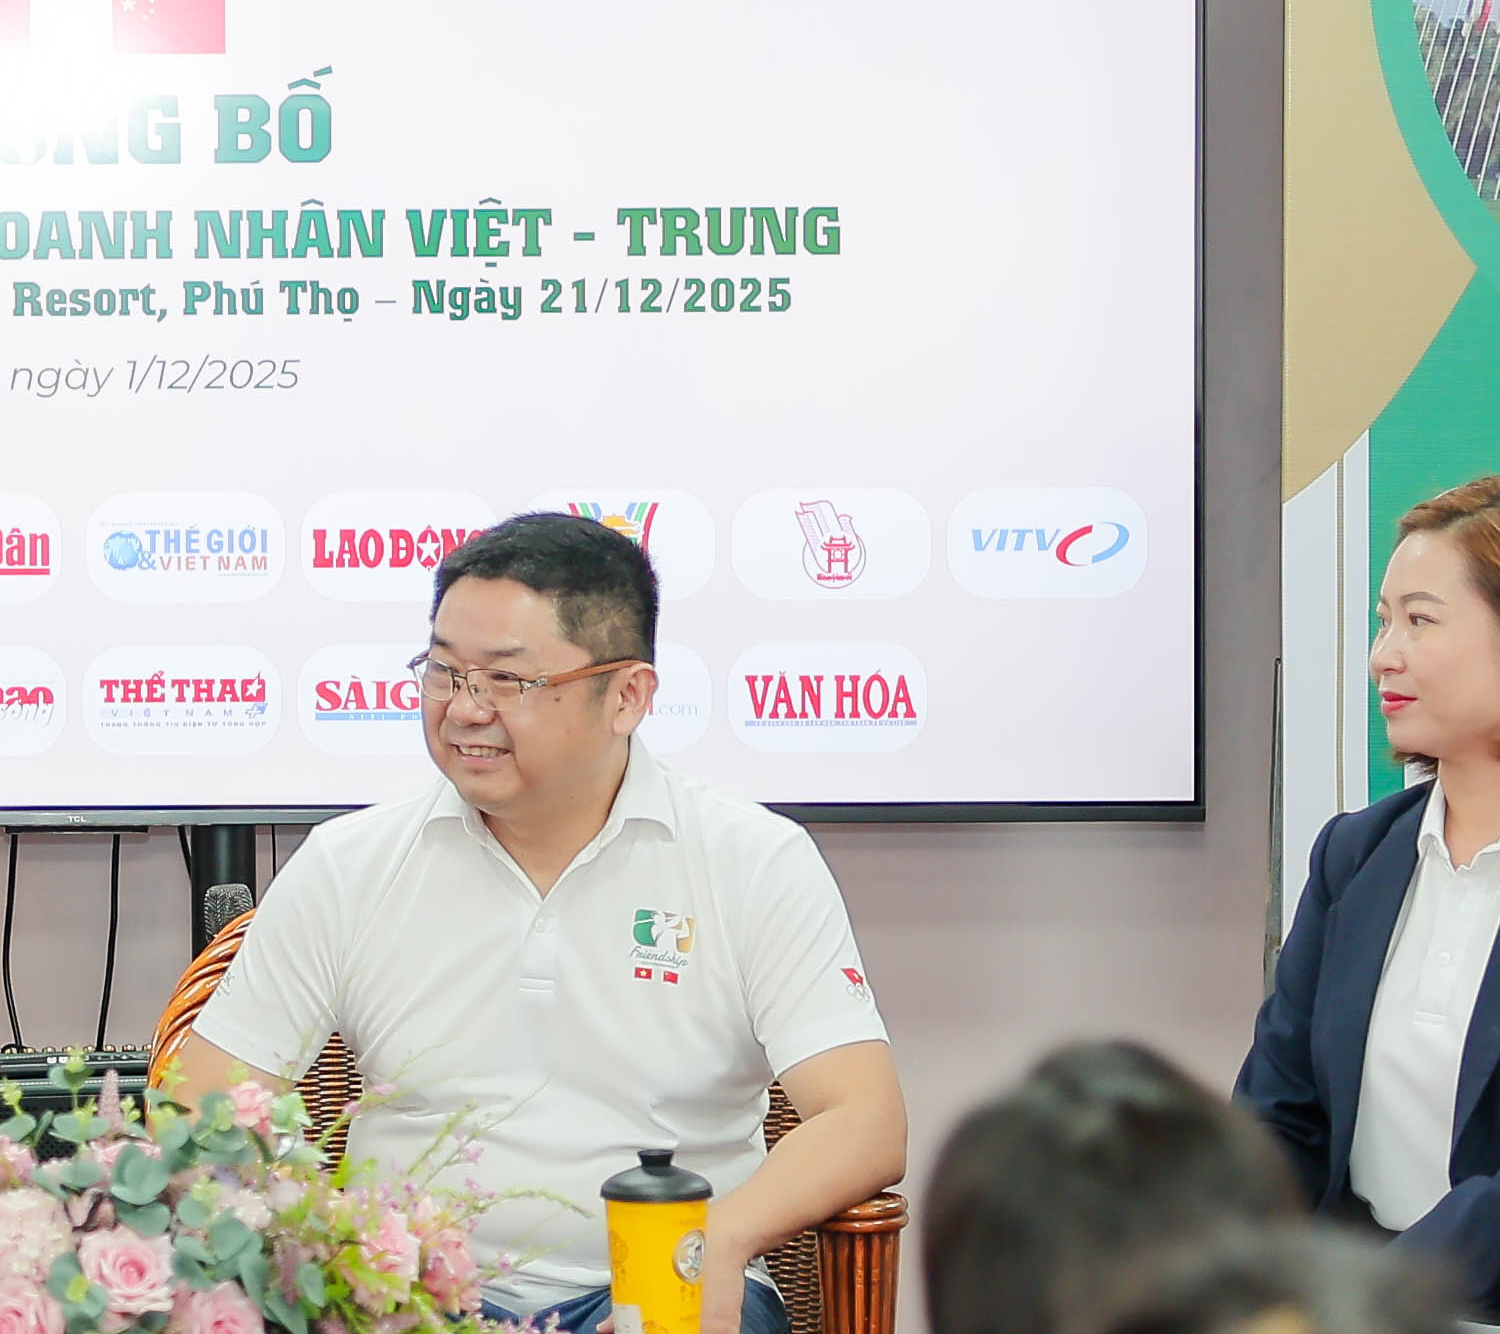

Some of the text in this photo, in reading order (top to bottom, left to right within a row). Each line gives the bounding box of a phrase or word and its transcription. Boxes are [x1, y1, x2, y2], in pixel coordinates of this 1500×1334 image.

[214, 65, 333, 164] BỐ
[193, 198, 386, 260] NHÂN
[406, 197, 553, 267] VIỆT
[616, 206, 841, 257] TRUNG
[12, 281, 170, 323] Resort,
[182, 279, 266, 317] Phú
[279, 280, 361, 323] Thọ
[411, 277, 524, 321] Ngày
[539, 277, 794, 315] 21/12/2025
[9, 357, 115, 398] ngày
[124, 354, 302, 393] 1/12/2025
[312, 528, 385, 569] LAO
[971, 527, 1062, 552] VITV
[217, 555, 269, 572] NAM
[100, 670, 166, 704] THỂ
[314, 674, 420, 712] SÀIG
[745, 668, 917, 719] VĂN HÓA
[67, 815, 87, 823] TCL
